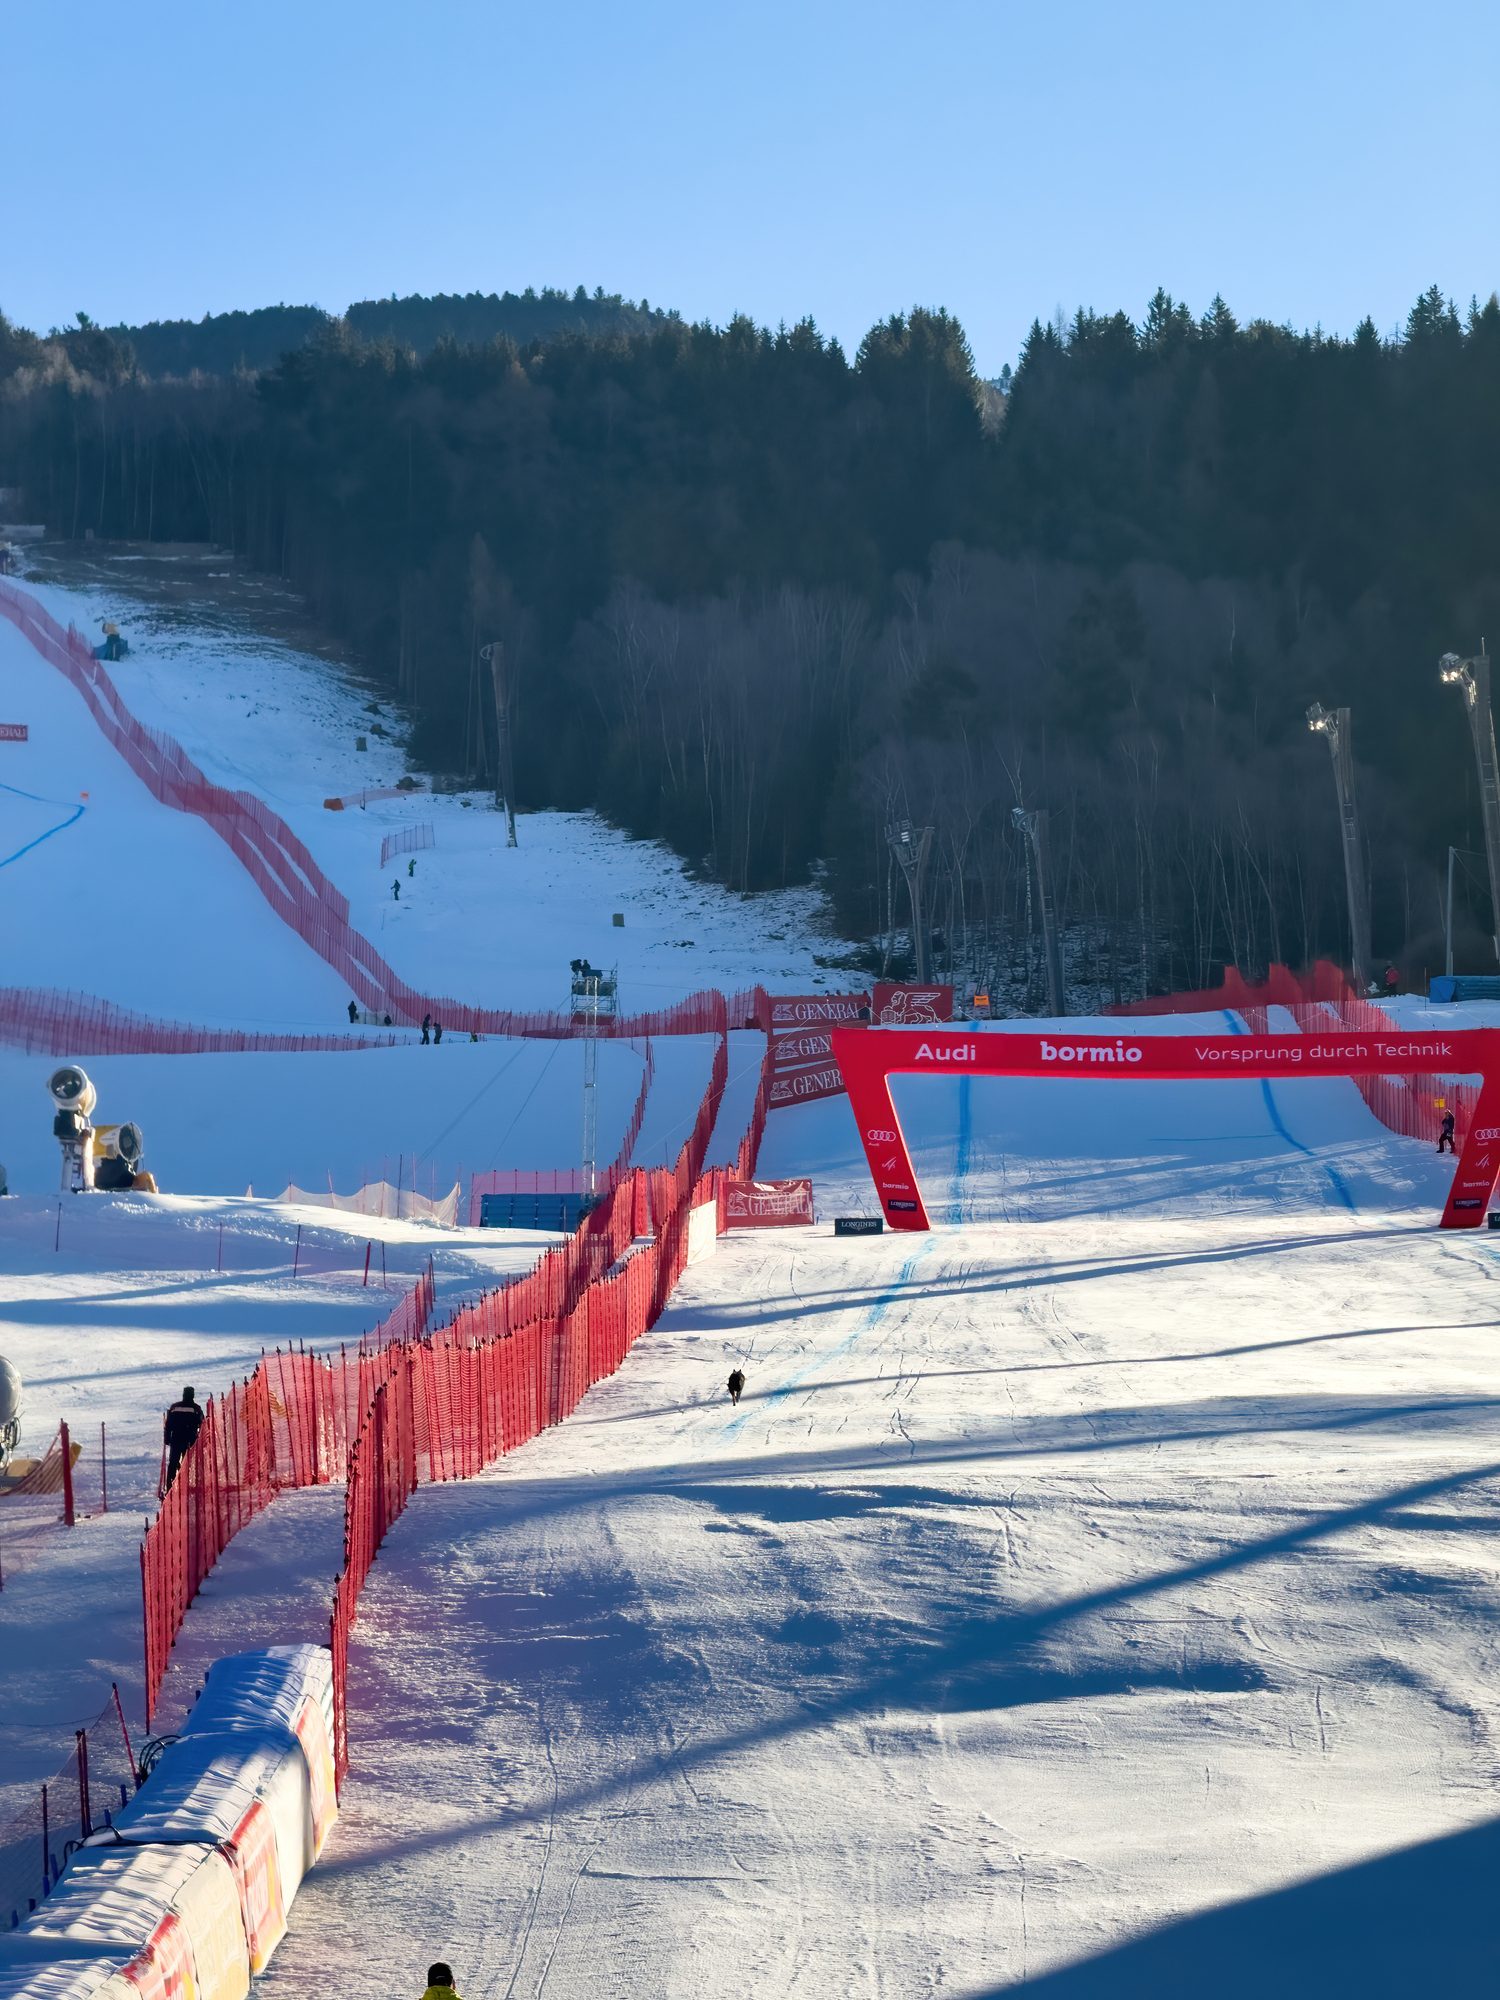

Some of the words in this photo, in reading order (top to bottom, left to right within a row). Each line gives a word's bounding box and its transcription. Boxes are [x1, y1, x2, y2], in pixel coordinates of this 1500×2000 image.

[914, 1043, 976, 1061] Audi
[1040, 1039, 1143, 1062] bormio
[1195, 1047, 1303, 1063] Vorsprung
[1309, 1044, 1368, 1058] durch
[1373, 1042, 1452, 1057] Technik
[793, 1068, 844, 1096] GENER
[882, 1182, 910, 1190] bormio
